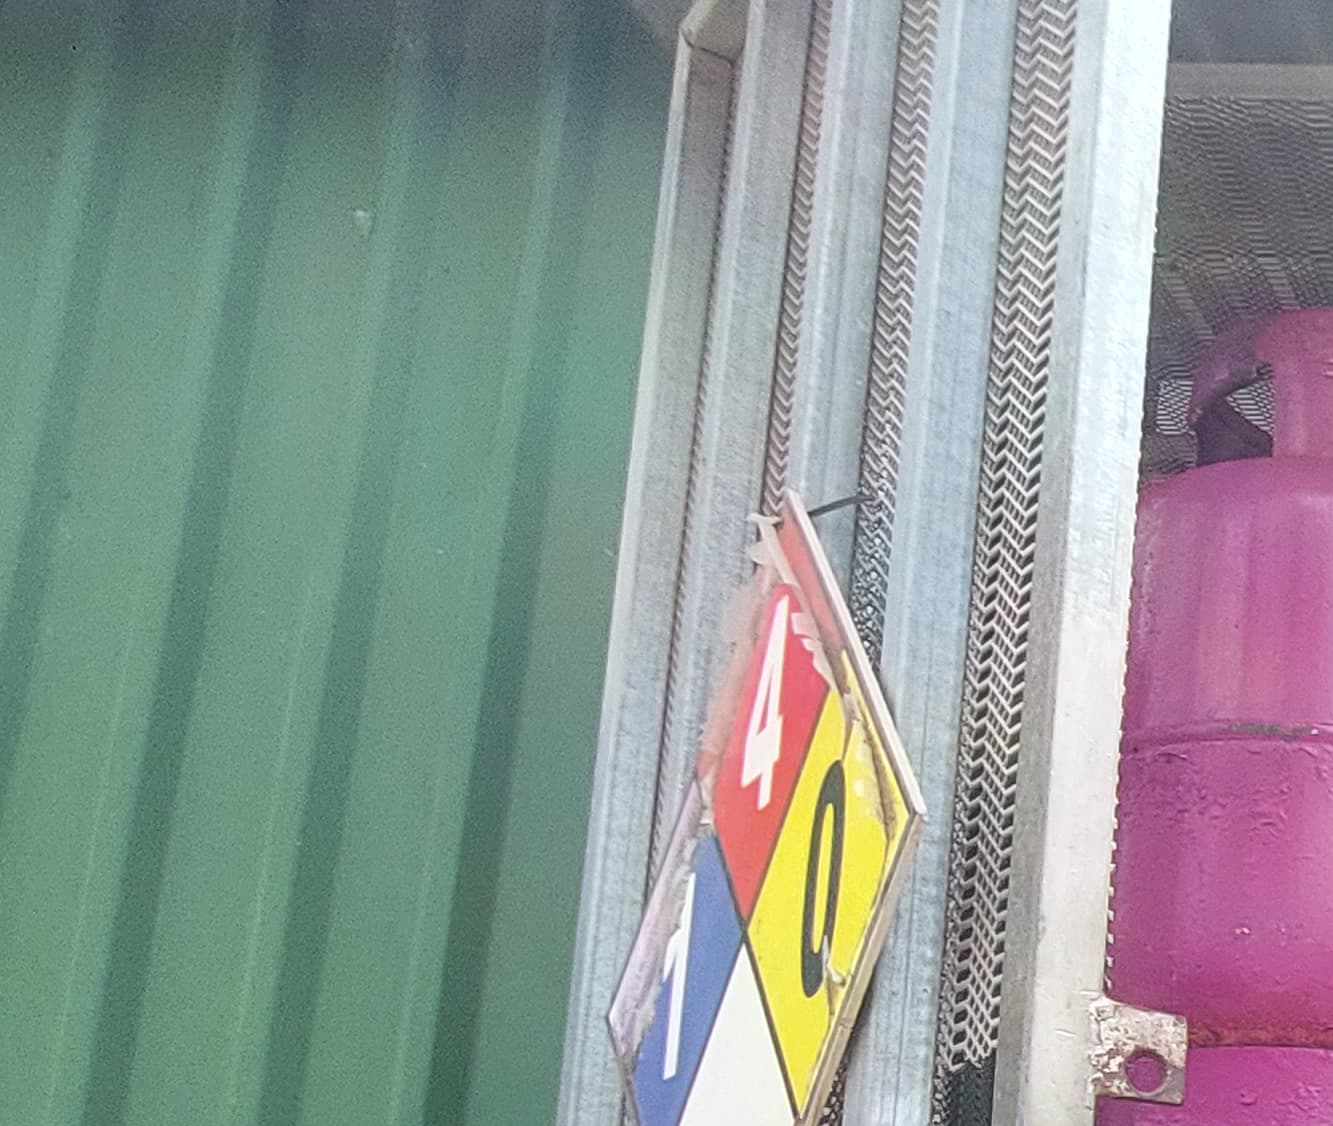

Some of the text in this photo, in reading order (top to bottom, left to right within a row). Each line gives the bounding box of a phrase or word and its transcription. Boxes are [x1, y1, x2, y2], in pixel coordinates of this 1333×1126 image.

[741, 595, 789, 811] 4
[663, 873, 696, 1081] 1
[801, 759, 846, 998] 0
